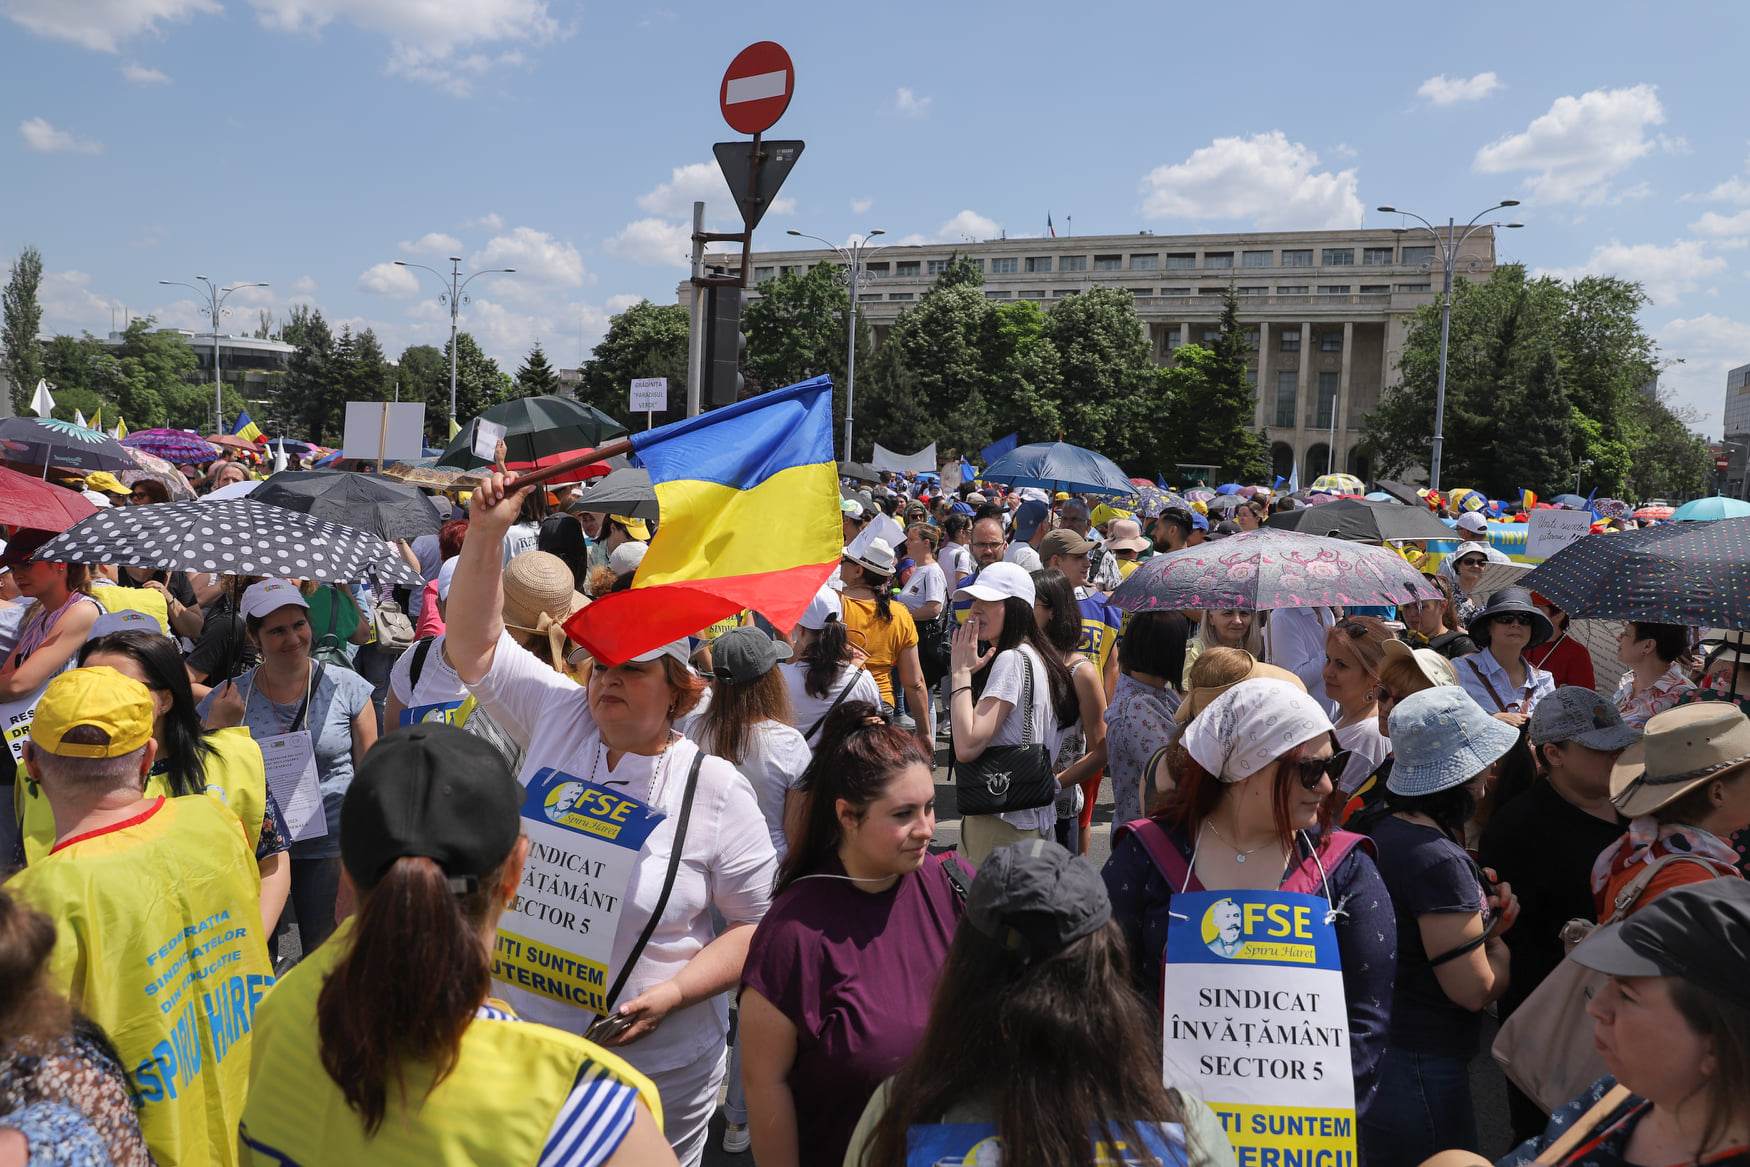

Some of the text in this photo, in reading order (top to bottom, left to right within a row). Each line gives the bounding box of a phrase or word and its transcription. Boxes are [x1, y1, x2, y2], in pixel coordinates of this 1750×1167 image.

[10, 710, 34, 725] RES
[12, 725, 32, 738] DR
[567, 815, 590, 828] Spiru
[575, 788, 639, 822] FSE
[528, 842, 606, 878] INDICAT
[522, 866, 618, 913] ĂȚĂMÂNT
[509, 895, 591, 935] ECTOR 5
[1243, 903, 1313, 939] FSE
[144, 927, 247, 996] SINDICATELOR
[527, 946, 604, 986] SUNTEM
[1245, 945, 1313, 959] Spiru Haret
[160, 988, 182, 1014] DIN
[491, 960, 604, 1010] UTERNICI!
[1199, 988, 1320, 1012] SINDICAT
[1171, 1014, 1343, 1047] ÎNVĂȚĂMÂNT
[136, 1001, 202, 1102] SPIRU
[1200, 1055, 1324, 1081] SECTOR 5
[1251, 1114, 1351, 1137] SUNTEM
[1232, 1145, 1352, 1167] ERNICI!
